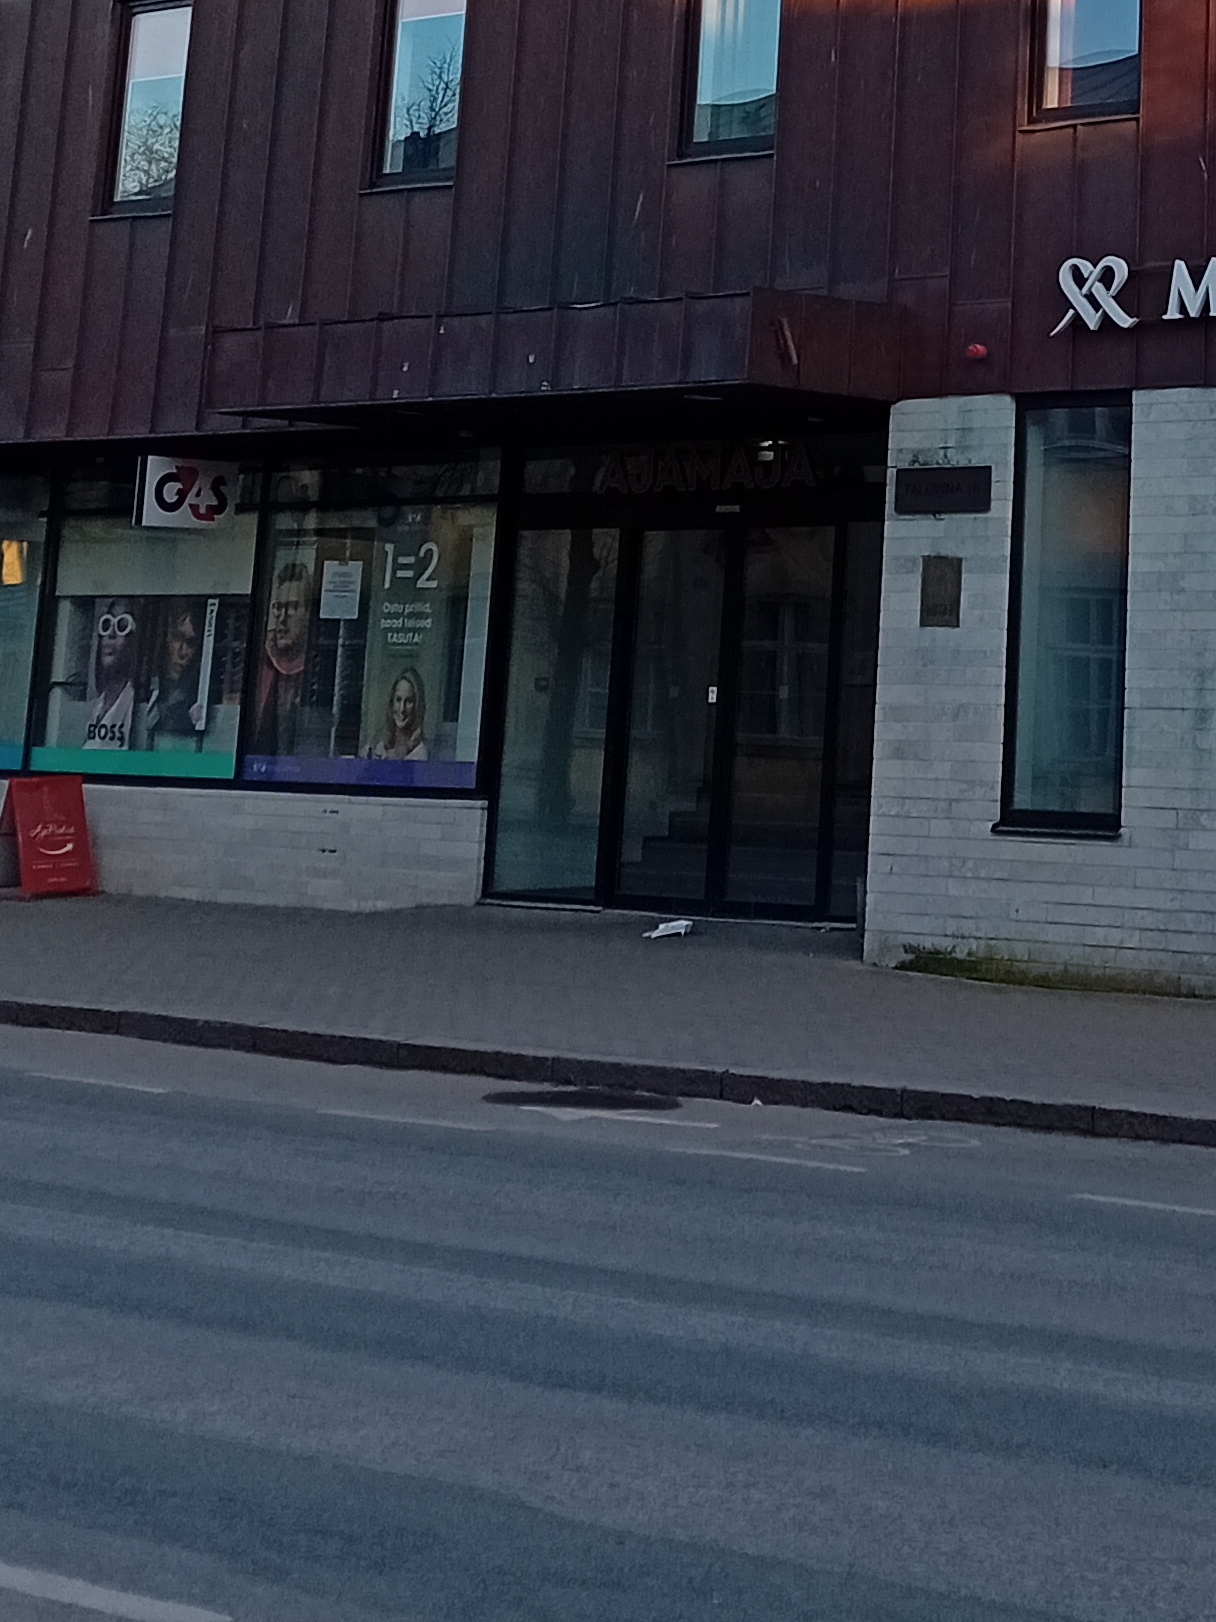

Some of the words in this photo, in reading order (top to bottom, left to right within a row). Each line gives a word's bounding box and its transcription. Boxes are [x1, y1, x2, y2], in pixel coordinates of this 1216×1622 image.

[154, 465, 228, 521] G4S
[593, 443, 816, 494] AJAMAJA
[87, 723, 125, 748] BOSS
